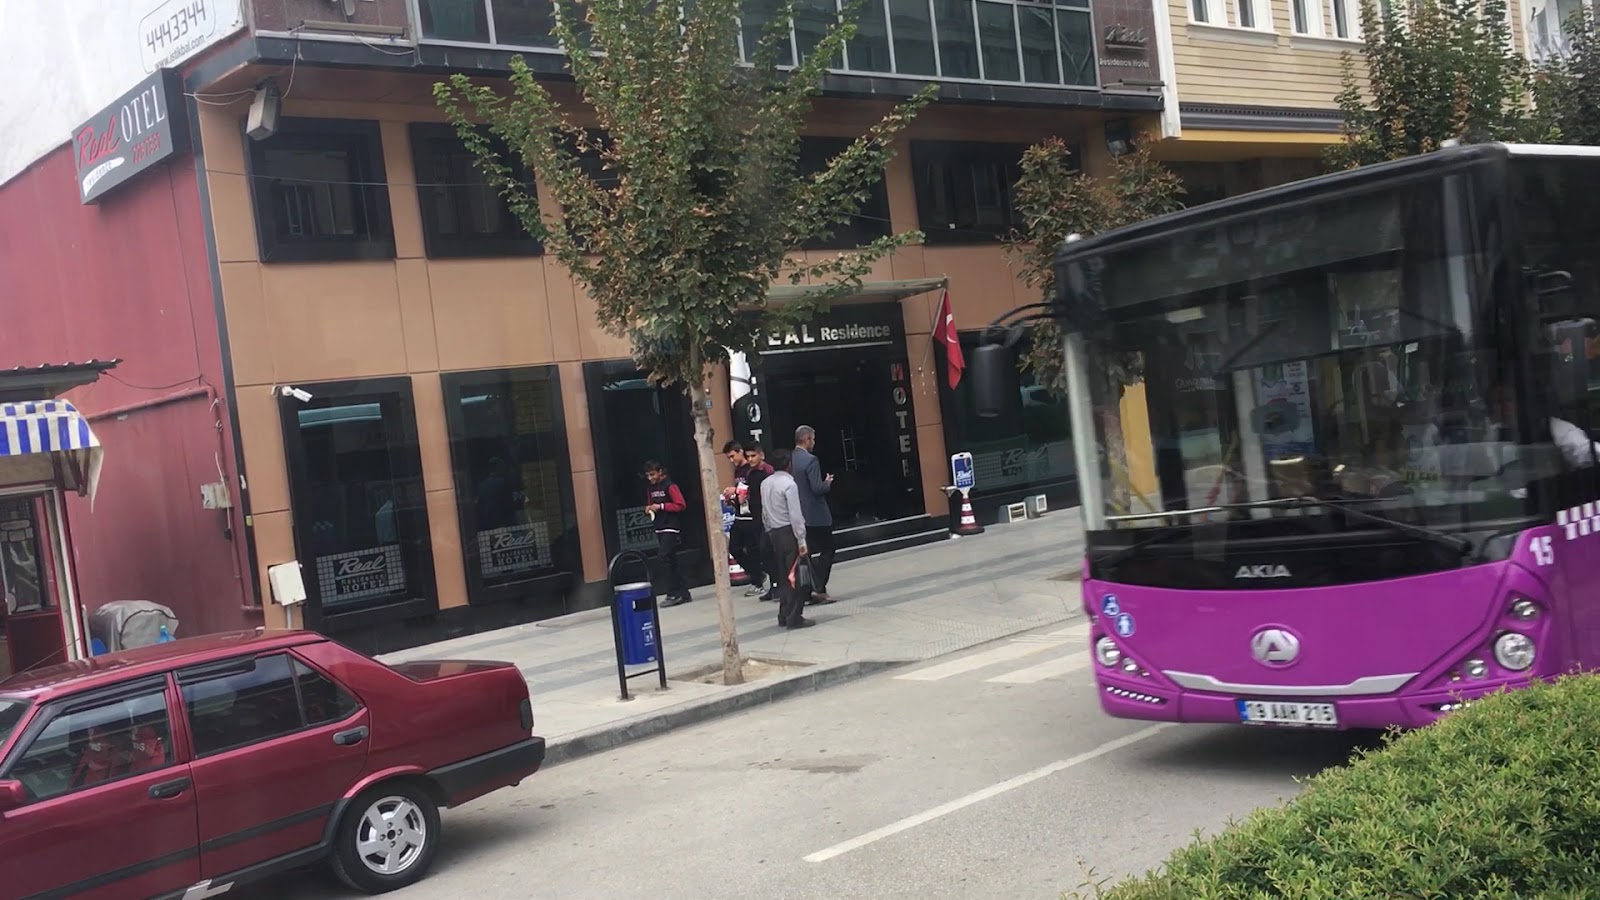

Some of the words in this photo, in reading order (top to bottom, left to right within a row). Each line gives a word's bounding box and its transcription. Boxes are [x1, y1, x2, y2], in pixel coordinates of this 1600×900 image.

[146, 0, 206, 54] 4443344
[120, 84, 166, 143] OTEL
[749, 323, 816, 346] EAL
[820, 323, 891, 341] Residence
[890, 362, 913, 478] HOTEL
[494, 531, 535, 549] Real
[1529, 535, 1554, 566] 15
[338, 555, 387, 575] Real
[1234, 564, 1293, 578] AKIA
[342, 579, 385, 594] HOTEL
[1302, 705, 1336, 722] 215
